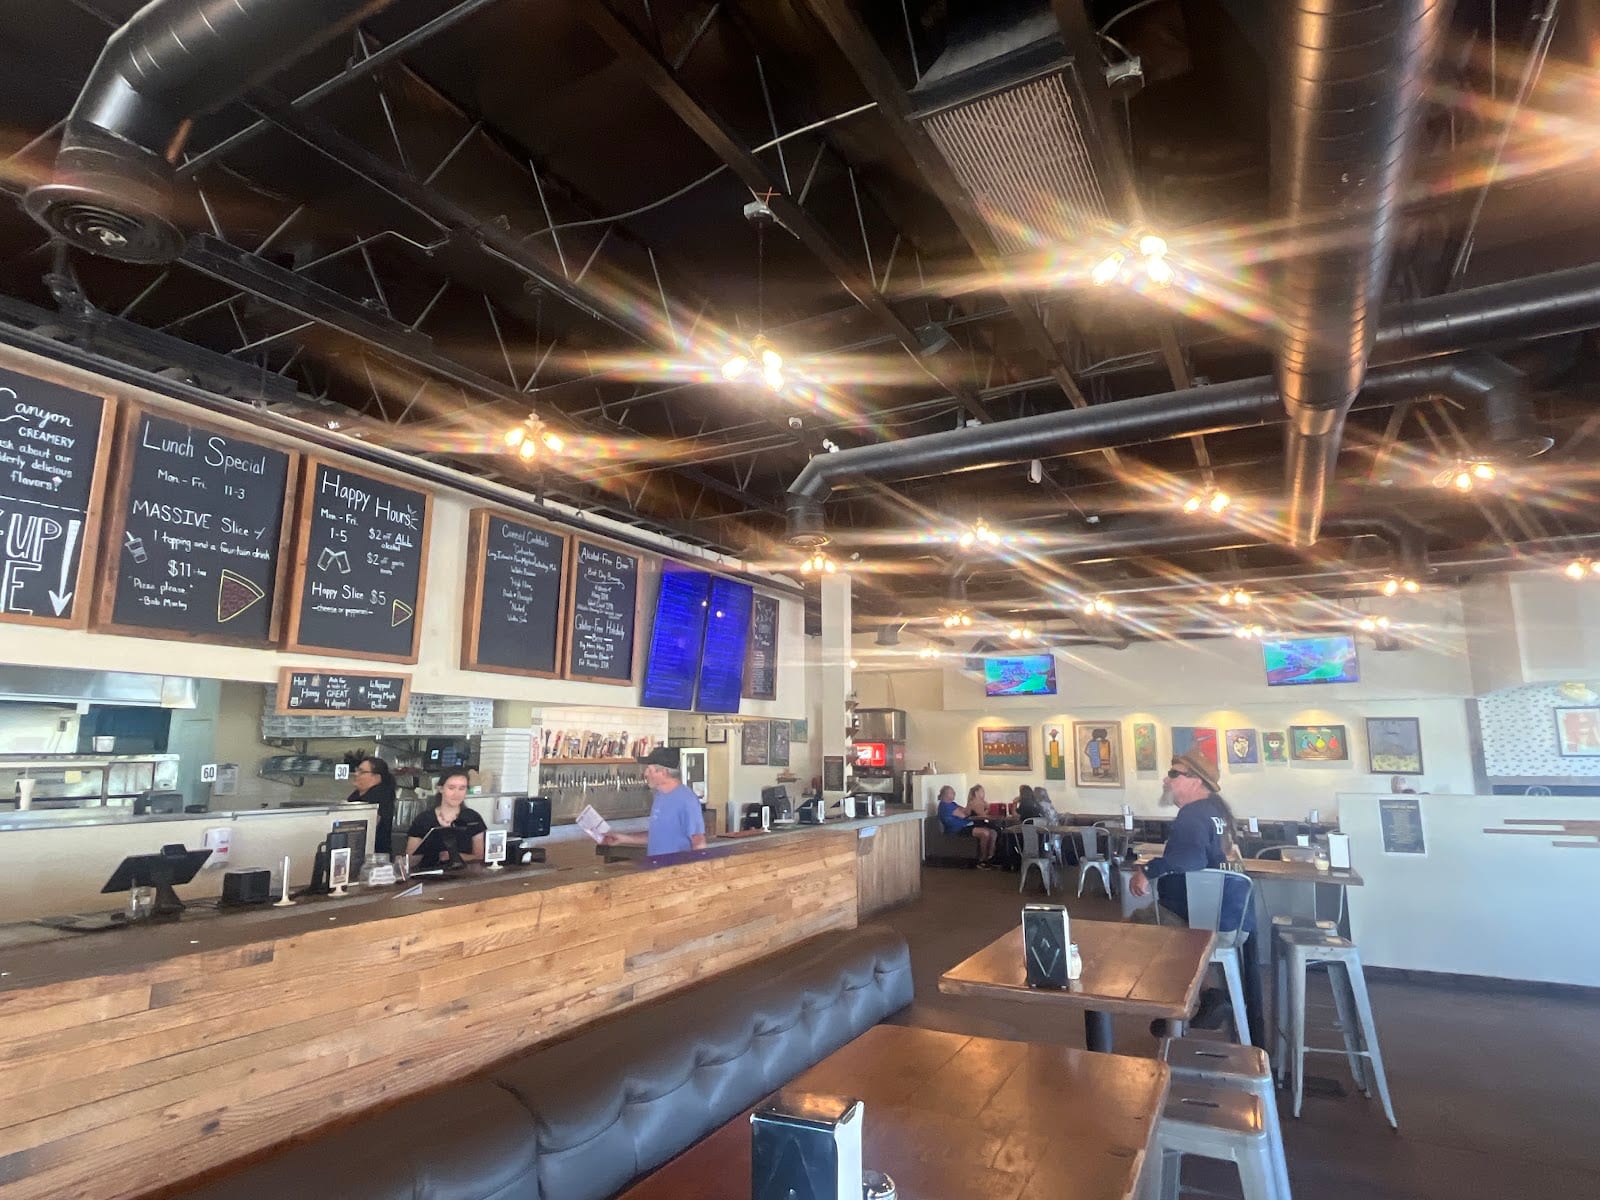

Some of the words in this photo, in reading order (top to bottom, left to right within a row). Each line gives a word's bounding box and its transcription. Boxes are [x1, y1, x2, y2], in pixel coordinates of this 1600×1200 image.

[18, 427, 75, 448] CREAMERY
[19, 444, 50, 458] about
[55, 454, 72, 463] our
[143, 420, 194, 457] Lunch
[205, 437, 266, 475] Special
[31, 460, 73, 478] delicious
[224, 485, 245, 500] 11-3
[322, 471, 371, 512] Happy
[375, 497, 411, 526] Hours
[133, 500, 212, 529] MASSIVE
[221, 517, 250, 537] Slice
[330, 527, 348, 542] 1-5
[368, 527, 382, 541] $2
[394, 533, 413, 548] ALL
[161, 532, 192, 552] topping
[194, 541, 209, 549] and
[252, 548, 271, 561] drink
[167, 559, 191, 577] $11
[366, 552, 380, 566] $2
[311, 581, 338, 600] Happy
[341, 584, 364, 600] Slice
[369, 589, 386, 606] $5
[294, 676, 307, 686] Hot
[301, 688, 320, 703] Honey
[326, 690, 349, 699] GREAT
[203, 767, 215, 779] 60
[336, 766, 348, 777] 30
